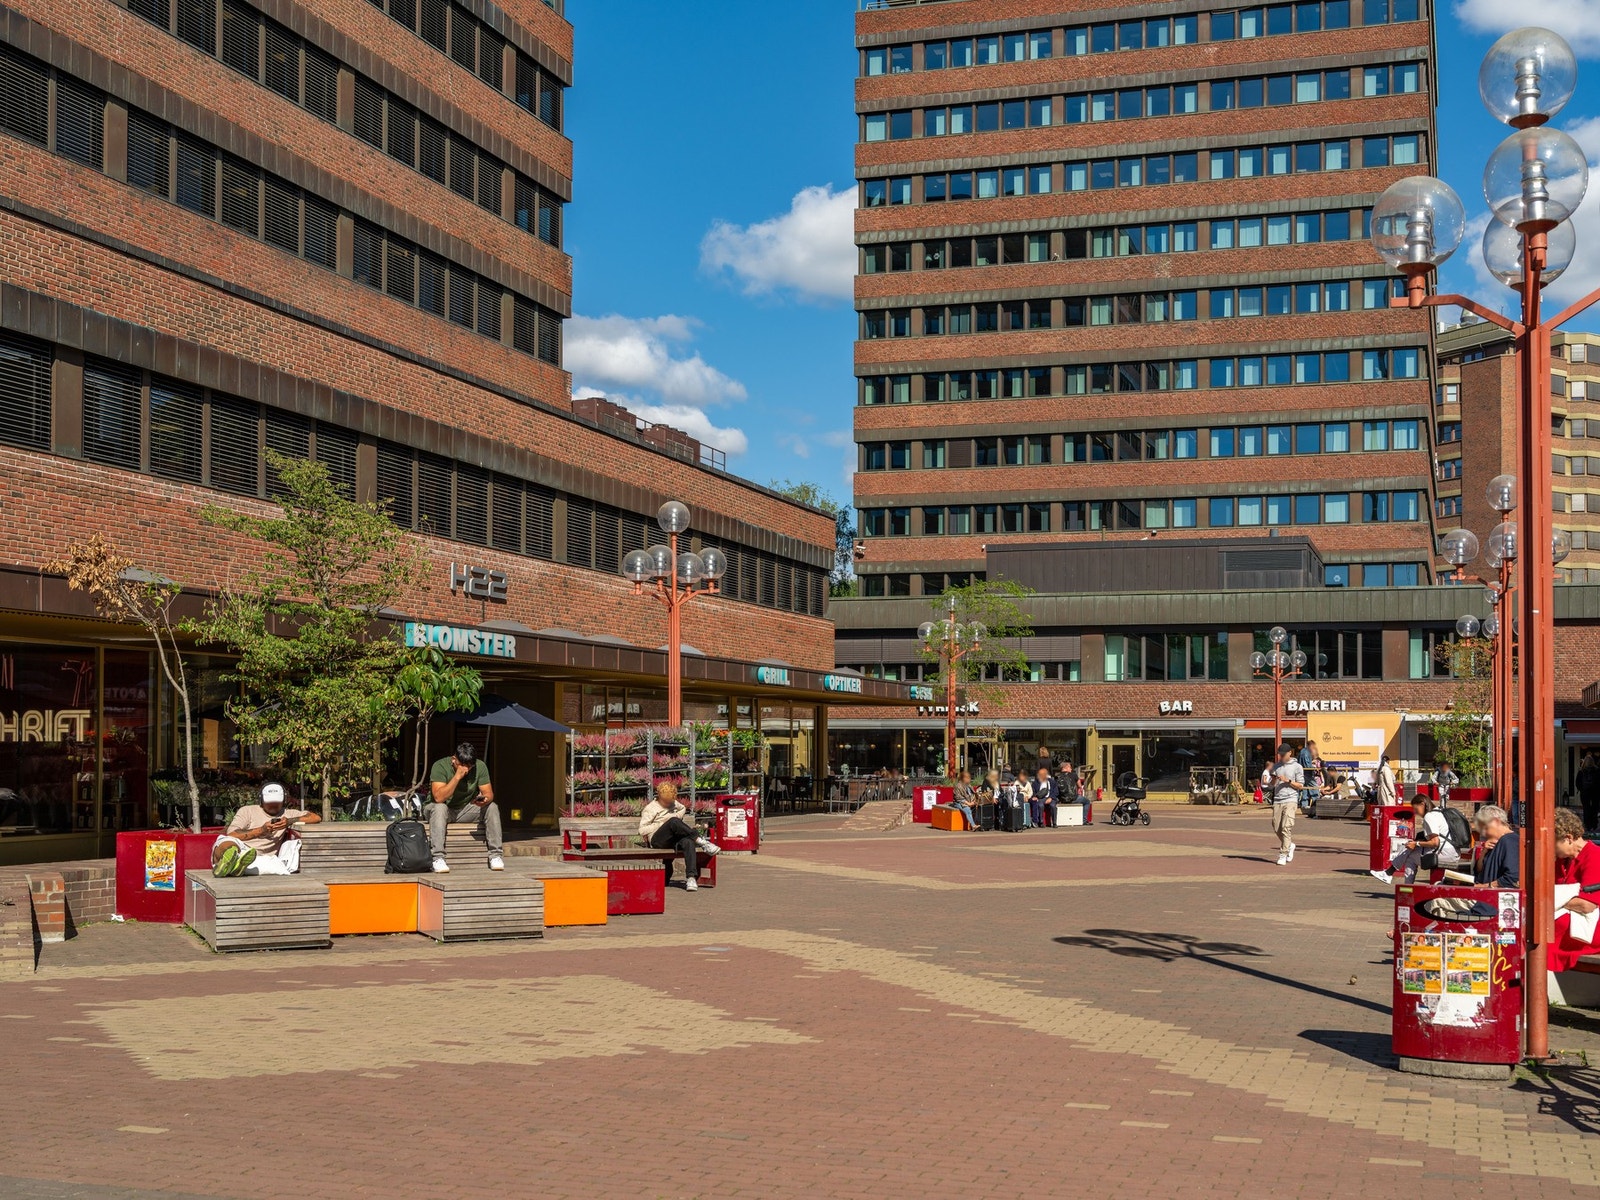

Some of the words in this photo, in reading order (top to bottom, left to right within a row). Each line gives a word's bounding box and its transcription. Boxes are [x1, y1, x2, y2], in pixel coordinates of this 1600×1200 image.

[450, 562, 507, 600] H22
[412, 622, 516, 658] BLOMSTER
[761, 666, 791, 686] GRILL
[827, 674, 862, 693] OPTIKER
[1159, 700, 1193, 713] BAR
[1287, 699, 1347, 712] BAKERI
